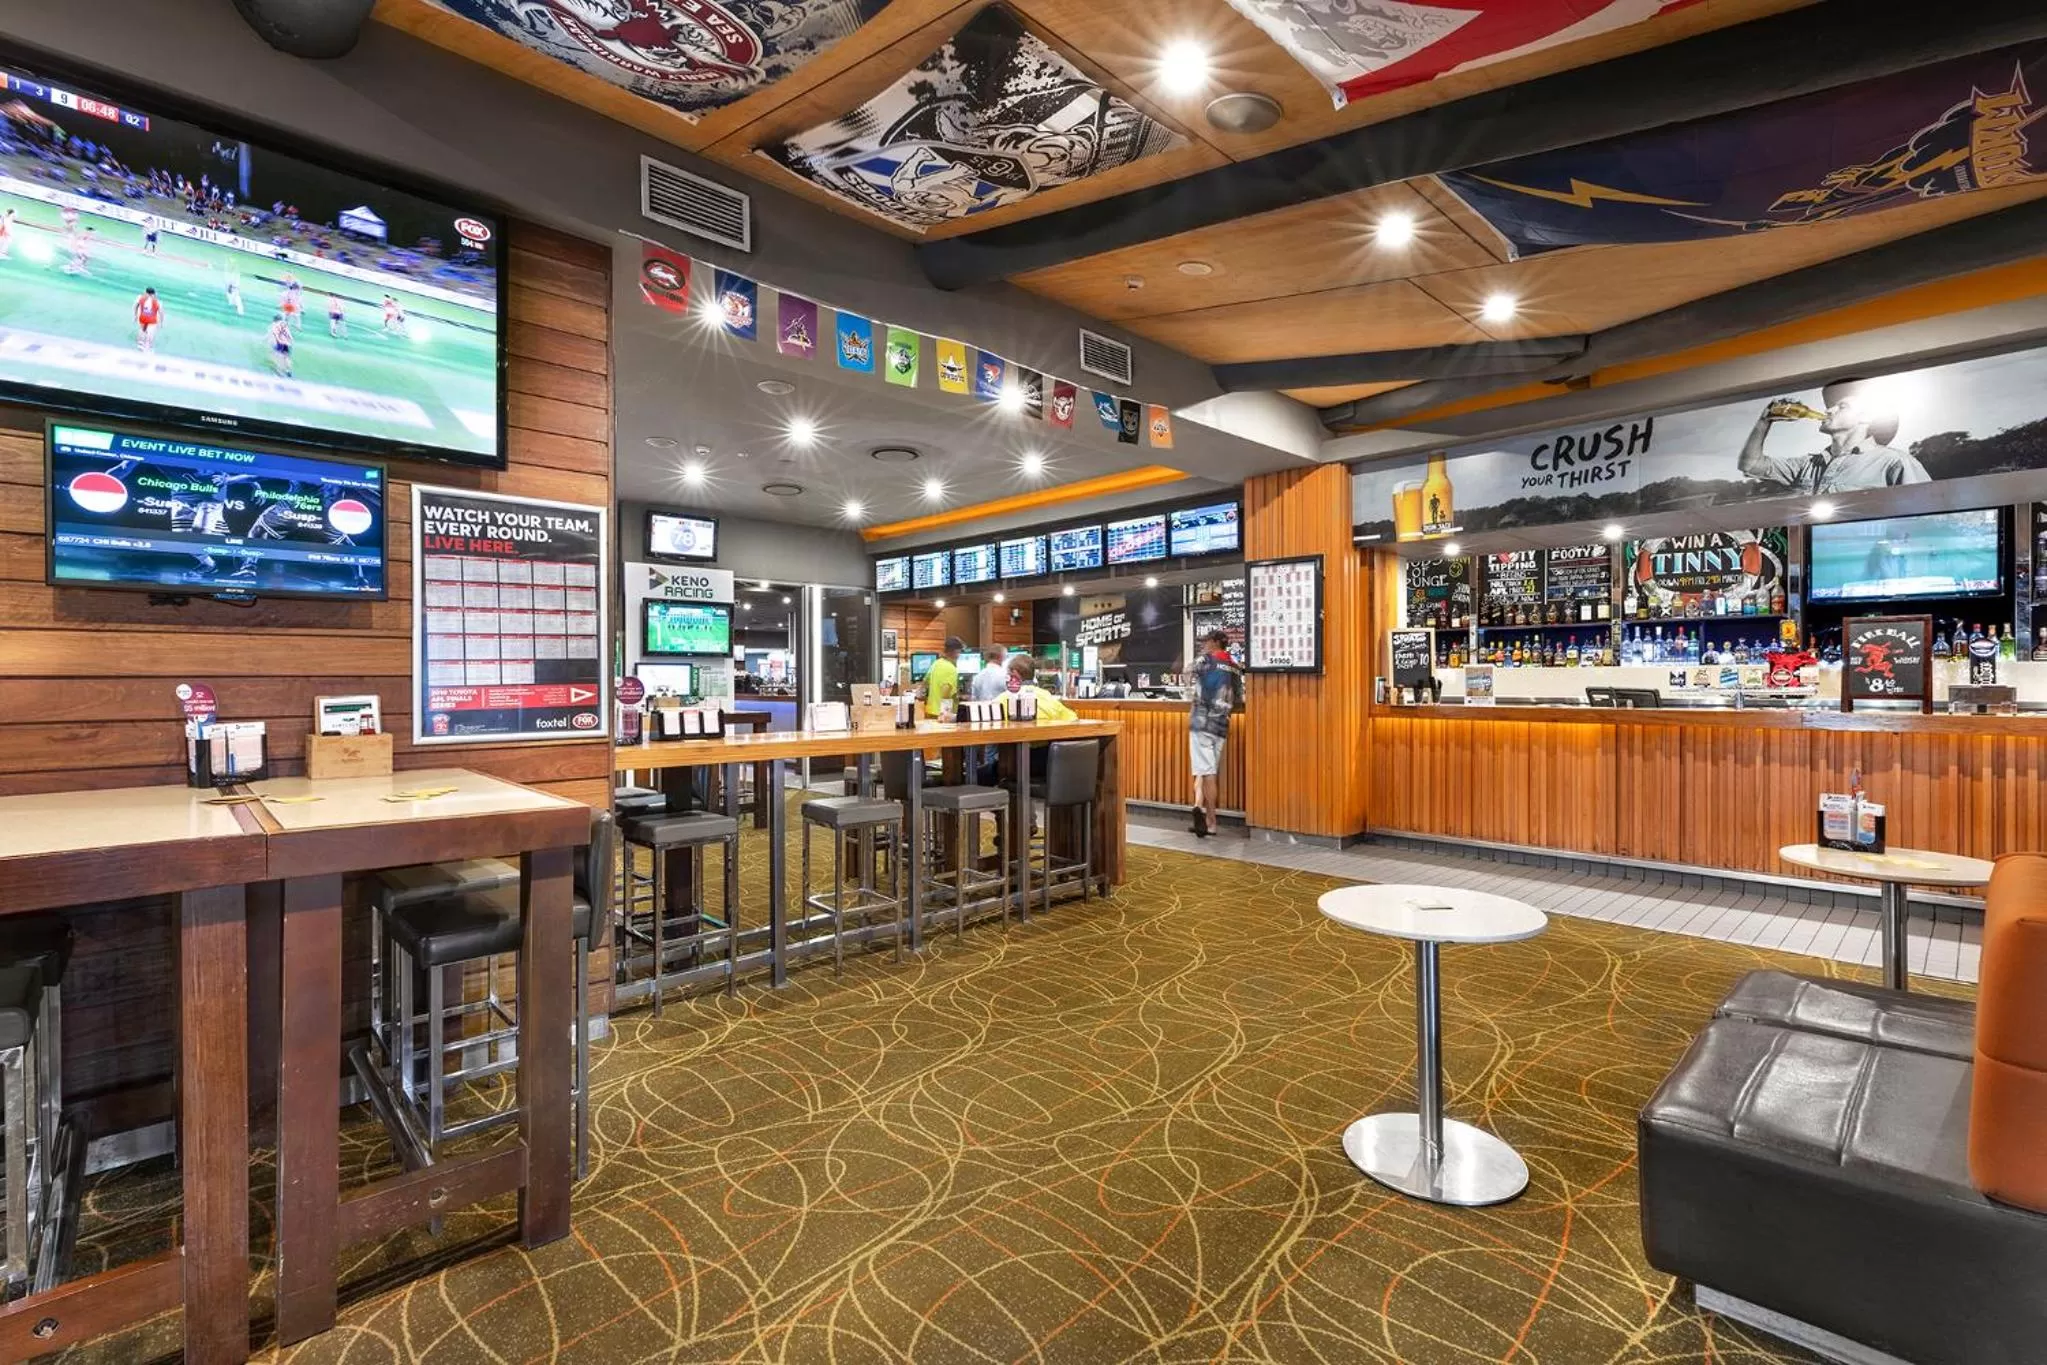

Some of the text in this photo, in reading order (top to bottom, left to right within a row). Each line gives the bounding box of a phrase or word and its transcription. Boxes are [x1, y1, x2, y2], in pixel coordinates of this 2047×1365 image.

[706, 13, 743, 46] SEA
[201, 415, 238, 427] SAMSUNG
[121, 438, 255, 463] EVENT LIVE BET NOW
[1531, 416, 1654, 472] CRUSH
[1521, 460, 1631, 489] YOUR THIRST
[137, 476, 219, 494] Chicago Bulls
[224, 500, 246, 511] VS
[254, 489, 320, 504] Philadelphia
[293, 502, 322, 512] 76ers
[423, 504, 593, 533] WATCH YOUR TEAM.
[423, 520, 553, 543] EVERY ROUND.
[423, 535, 519, 554] LIVE HERE.
[1671, 533, 1723, 550] WIN A
[1551, 548, 1591, 560] FOOTY
[1654, 547, 1742, 576] TINNY
[1488, 560, 1536, 572] TIPPING
[671, 575, 710, 588] KENO
[664, 585, 714, 599] RACING
[1081, 613, 1113, 633] HOME
[1075, 621, 1132, 648] SPORTS
[1851, 628, 1921, 648] FIREBALL
[536, 716, 593, 729] foxtel FOX
